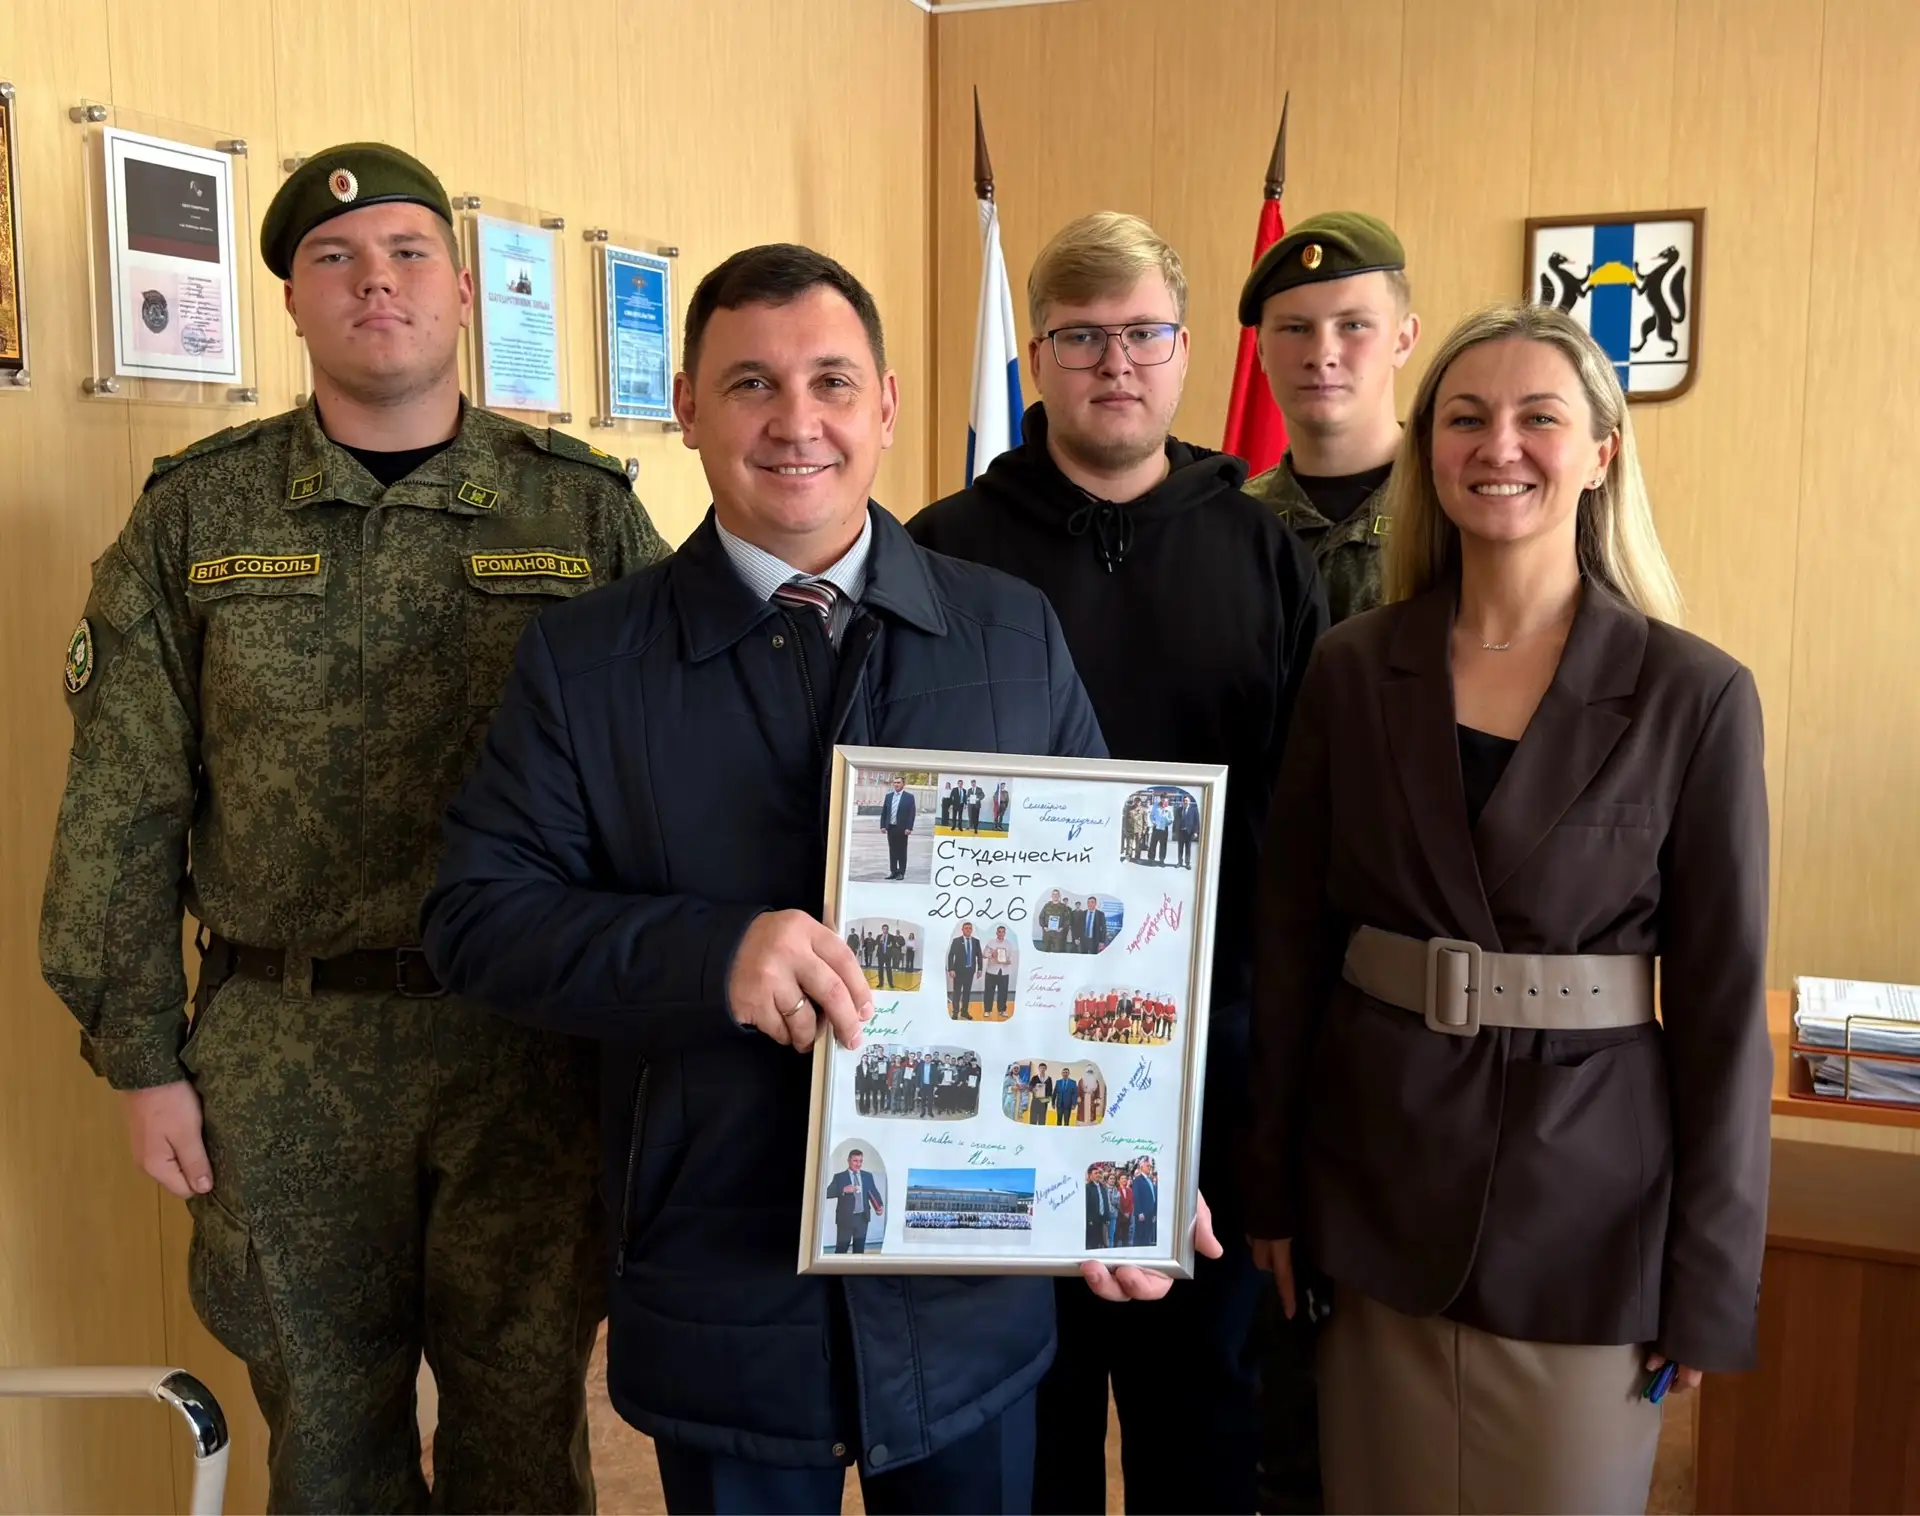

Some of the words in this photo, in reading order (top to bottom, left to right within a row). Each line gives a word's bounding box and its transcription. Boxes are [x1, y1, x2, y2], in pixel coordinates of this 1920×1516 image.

[197, 563, 228, 579] ВПК
[234, 560, 311, 573] СОБОЛЬ
[477, 557, 556, 572] РОМАНОВ
[560, 561, 586, 575] Д.А.
[937, 840, 1093, 866] Студенческий
[935, 866, 1031, 887] Совет
[928, 892, 1027, 921] 2026
